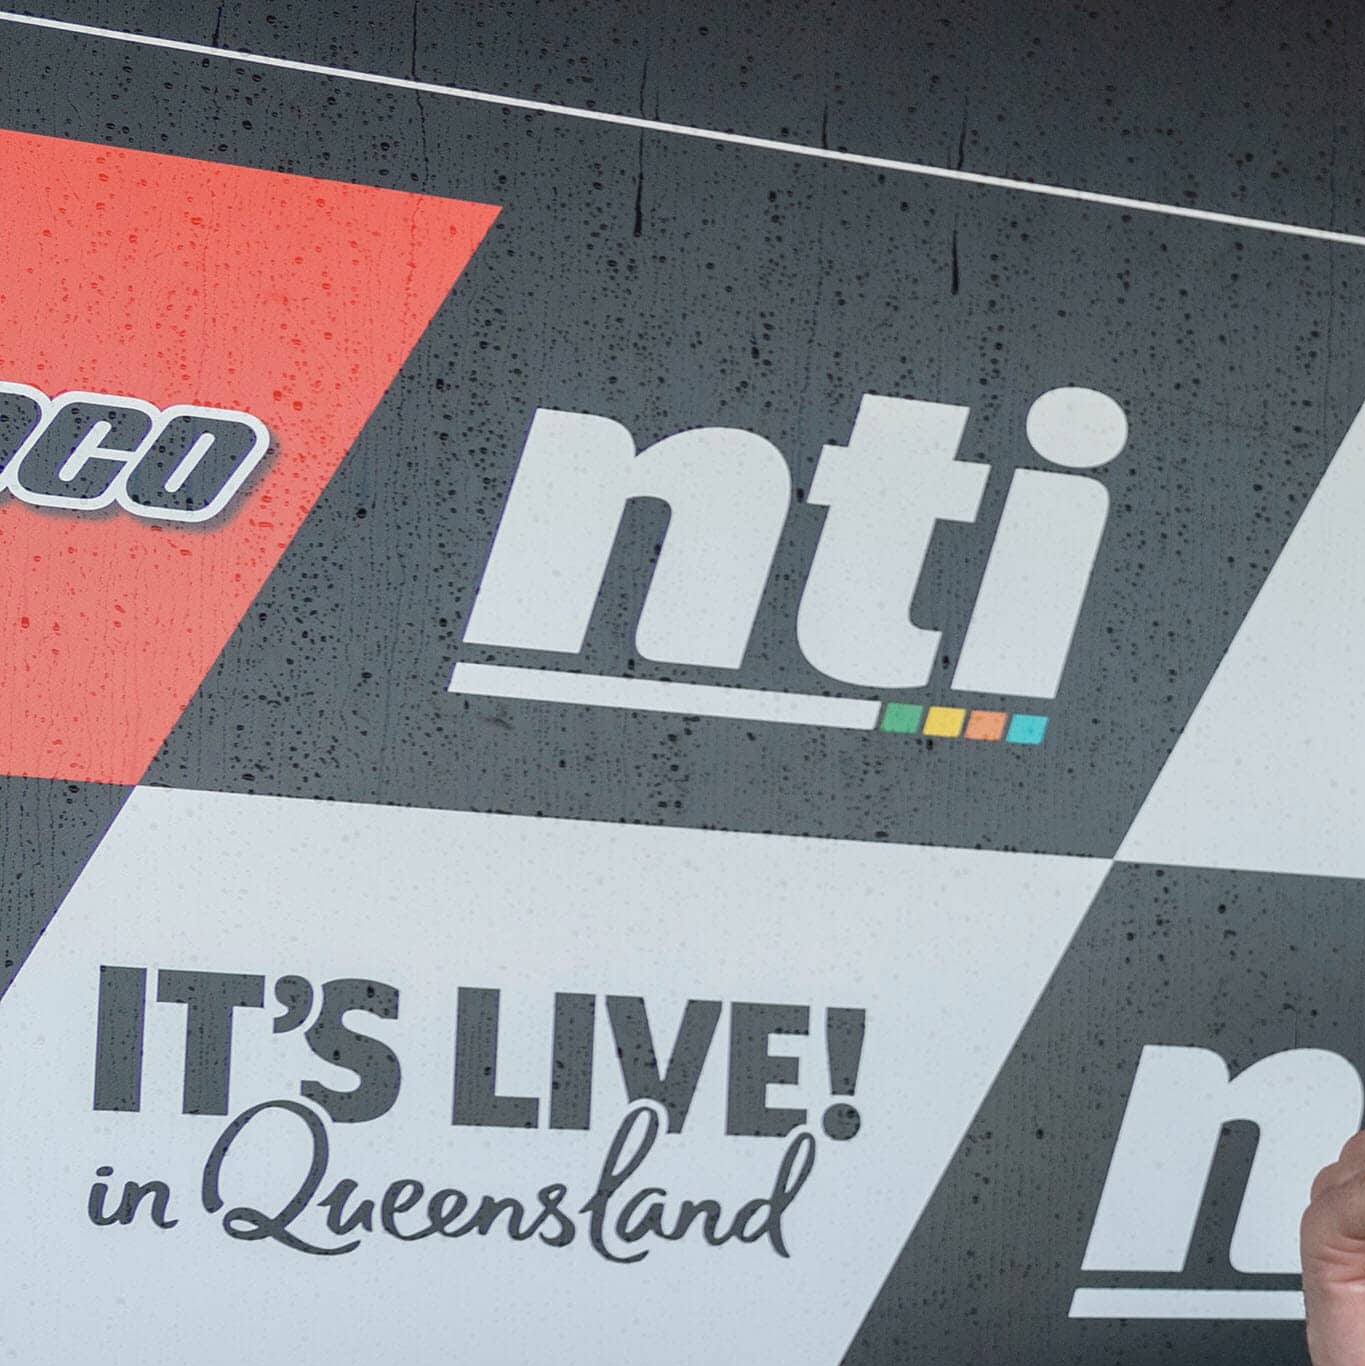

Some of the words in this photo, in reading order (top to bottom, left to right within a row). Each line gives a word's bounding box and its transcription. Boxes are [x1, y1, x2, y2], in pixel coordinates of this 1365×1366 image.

[463, 386, 1128, 699] nti
[451, 985, 866, 1141] LIVE!
[87, 1165, 178, 1231] in
[201, 1098, 816, 1264] Queensland
